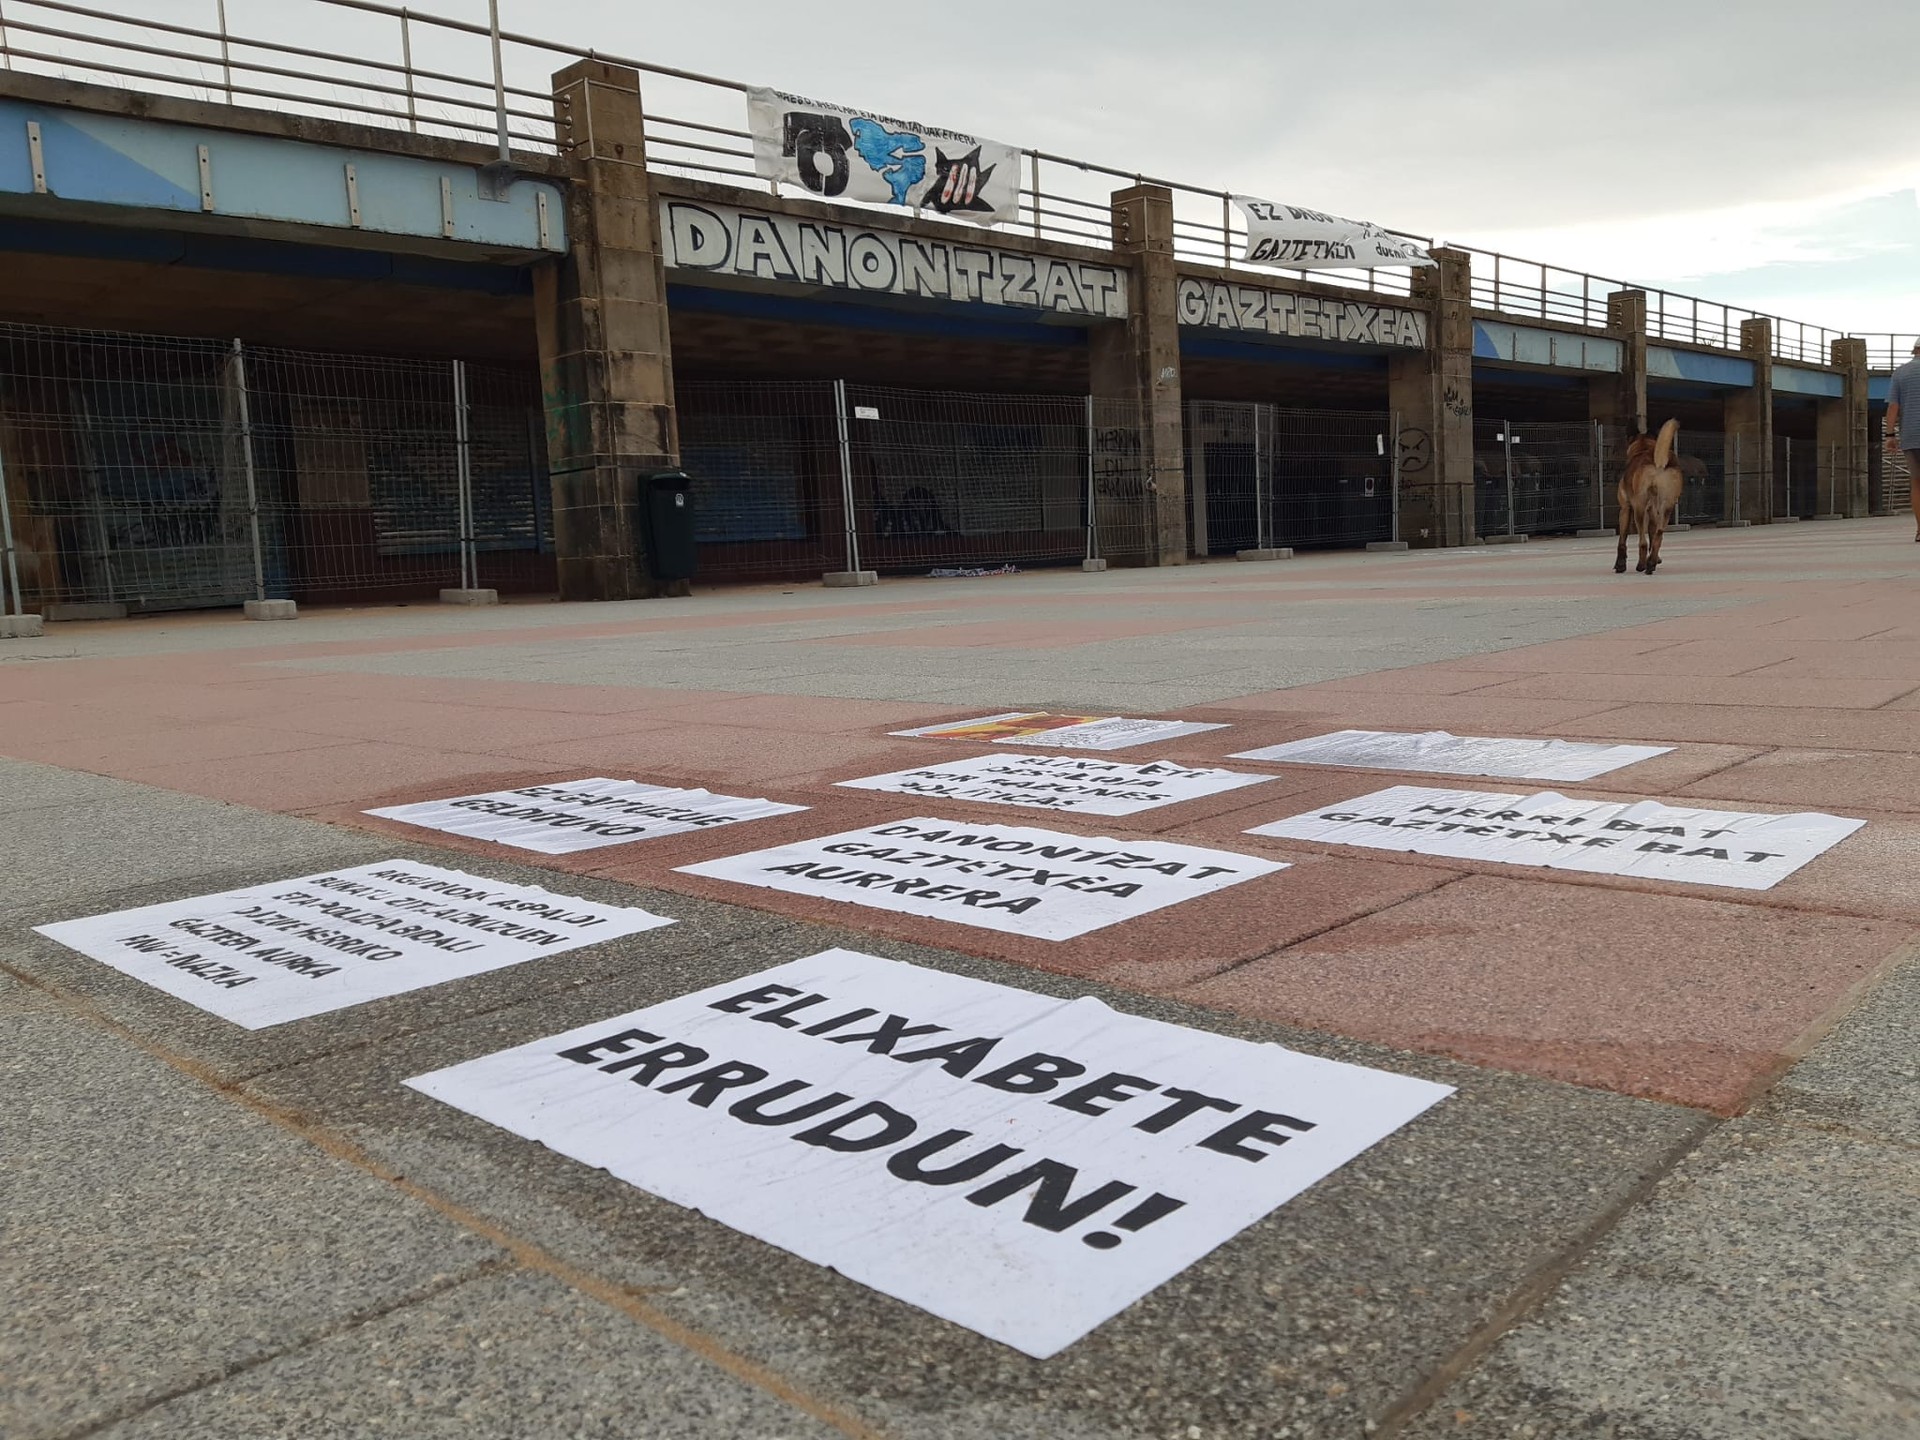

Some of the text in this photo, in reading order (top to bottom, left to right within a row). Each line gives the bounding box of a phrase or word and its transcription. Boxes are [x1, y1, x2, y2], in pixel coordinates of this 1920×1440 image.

[942, 130, 978, 146] ETXERA
[1247, 203, 1283, 221] EZ
[668, 202, 1117, 314] DANONTZAT
[1178, 278, 1426, 349] GAZTETXEA
[905, 771, 1173, 801] POR RAZONES
[979, 767, 1163, 787] DESALOJA
[1015, 757, 1214, 779] ELIXAETE
[513, 787, 568, 798] EZ
[450, 799, 646, 836] GELDITUKO
[1409, 804, 1738, 840] HERRI BAT
[870, 823, 1244, 881] DANONTZAT
[1319, 812, 1786, 863] GAZTETXE BAT
[764, 861, 1046, 916] AURRERA
[822, 841, 1146, 900] GAZTETXEA
[309, 877, 395, 901] BUKATU
[272, 891, 486, 953] ETA POLIZIA BIDALI
[491, 898, 608, 928] ASPALDI
[168, 918, 342, 979] GAZTEEN AURKA
[291, 927, 404, 961] HERRIKO
[166, 953, 258, 989] NAZKA
[706, 983, 1319, 1163] ELIXABETE
[554, 1028, 1189, 1250] ERRUDUN!
